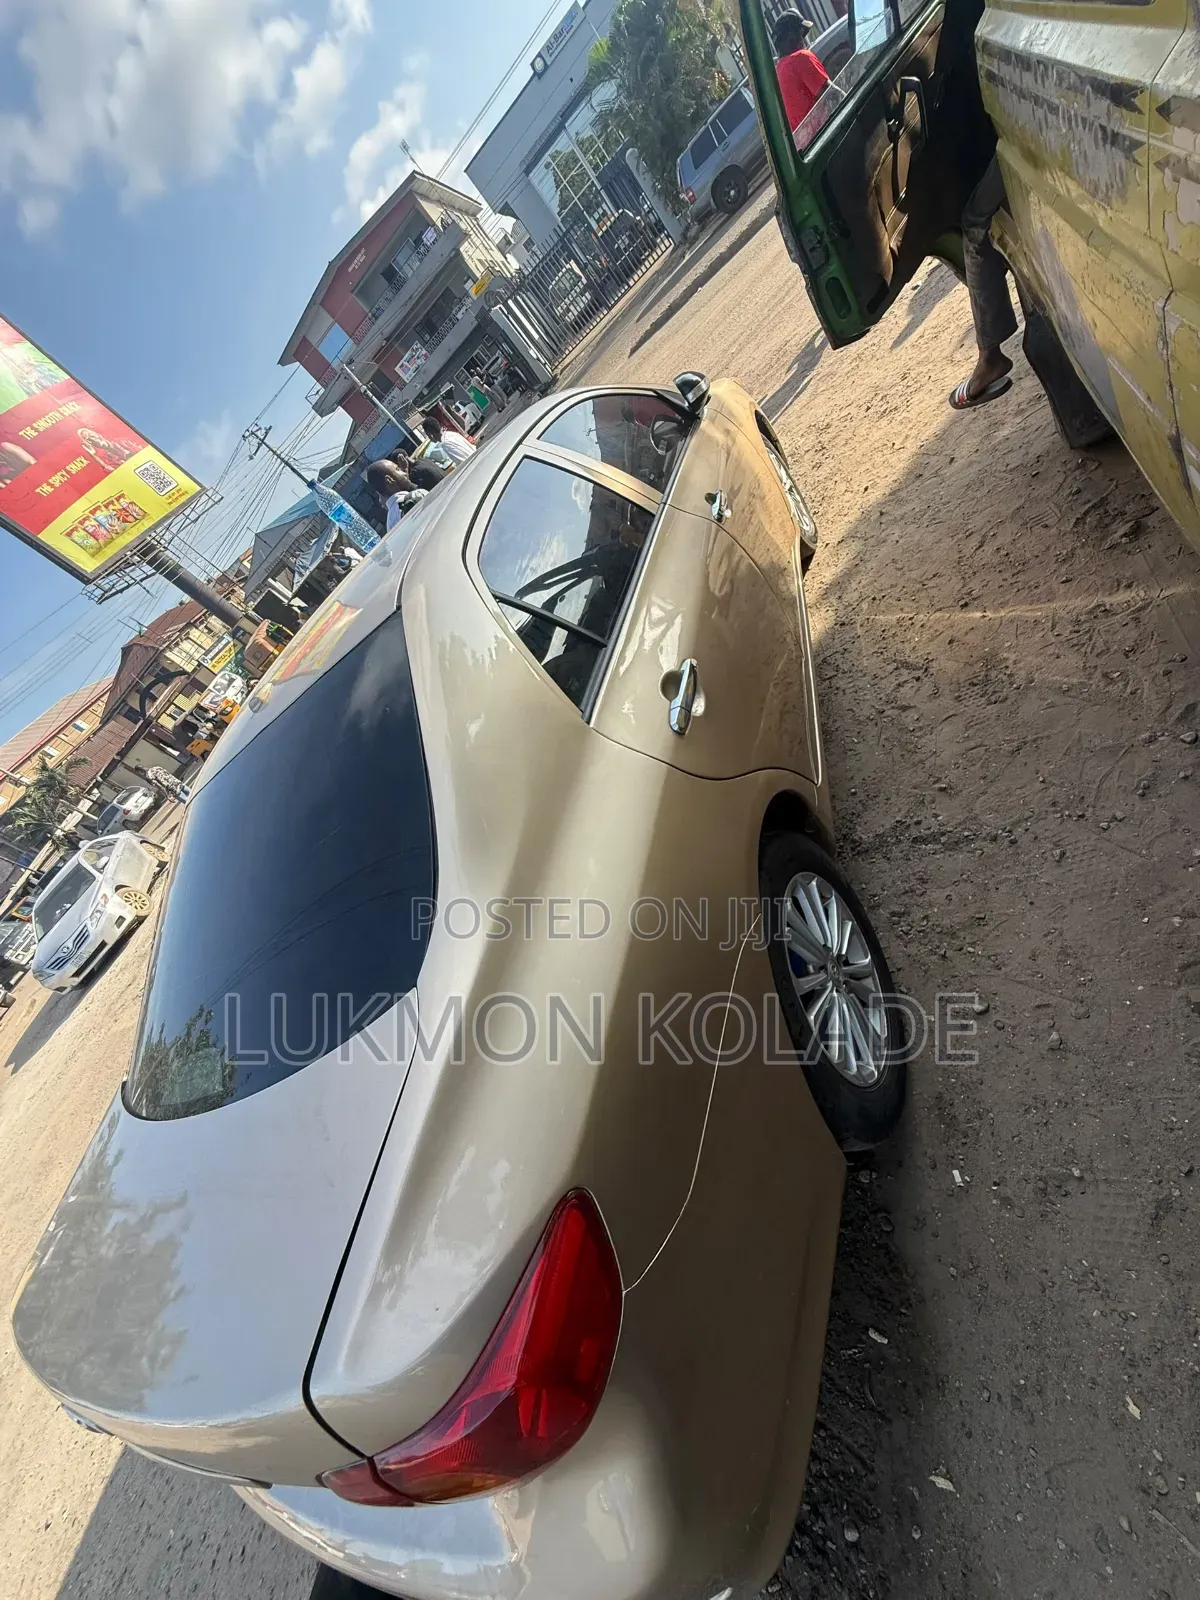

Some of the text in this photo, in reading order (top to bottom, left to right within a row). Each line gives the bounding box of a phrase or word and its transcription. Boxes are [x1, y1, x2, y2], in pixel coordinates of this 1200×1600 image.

[18, 426, 39, 440] THE
[32, 410, 64, 432] SMOOTH
[35, 455, 90, 497] THE SPICY SNACK
